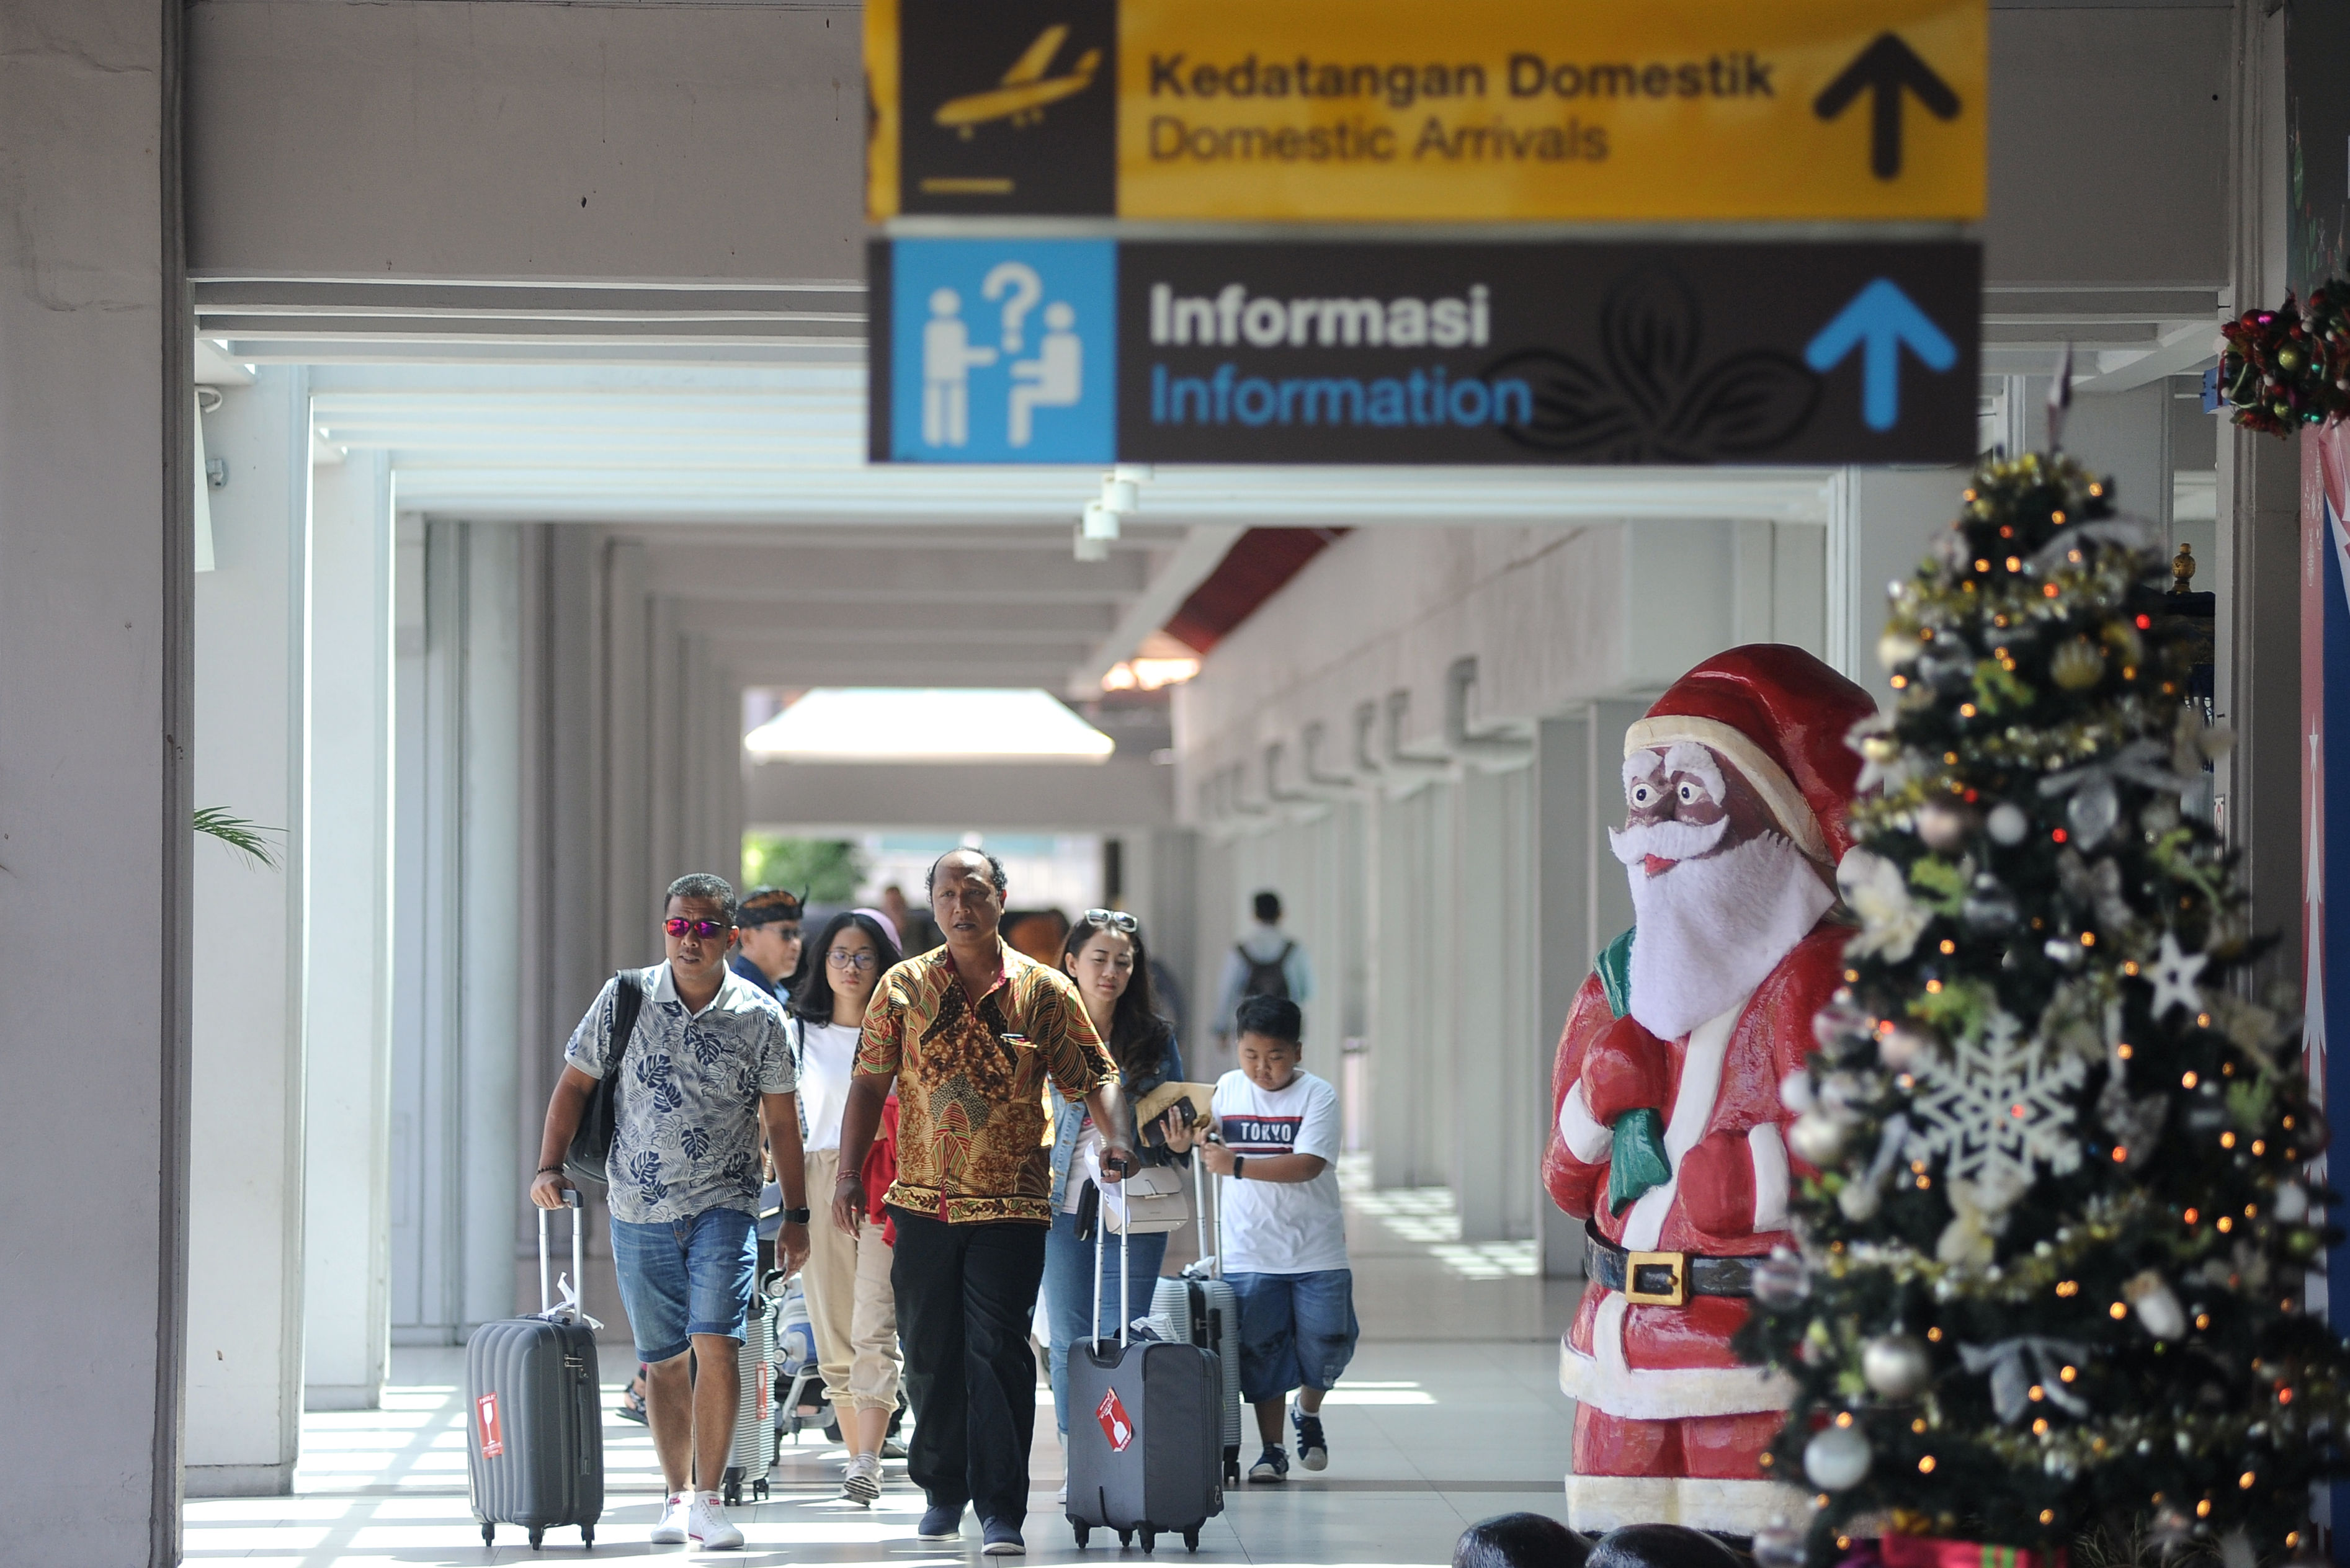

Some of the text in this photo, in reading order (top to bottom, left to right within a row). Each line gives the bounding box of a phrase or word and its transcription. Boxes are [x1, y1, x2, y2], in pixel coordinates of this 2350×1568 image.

[1148, 52, 1774, 108] Kedatangan Domestik
[1149, 115, 1608, 163] Domestic Arrivals
[1150, 282, 1489, 346] Informasi
[1151, 363, 1532, 427] Information
[1241, 1122, 1292, 1142] TOKYO
